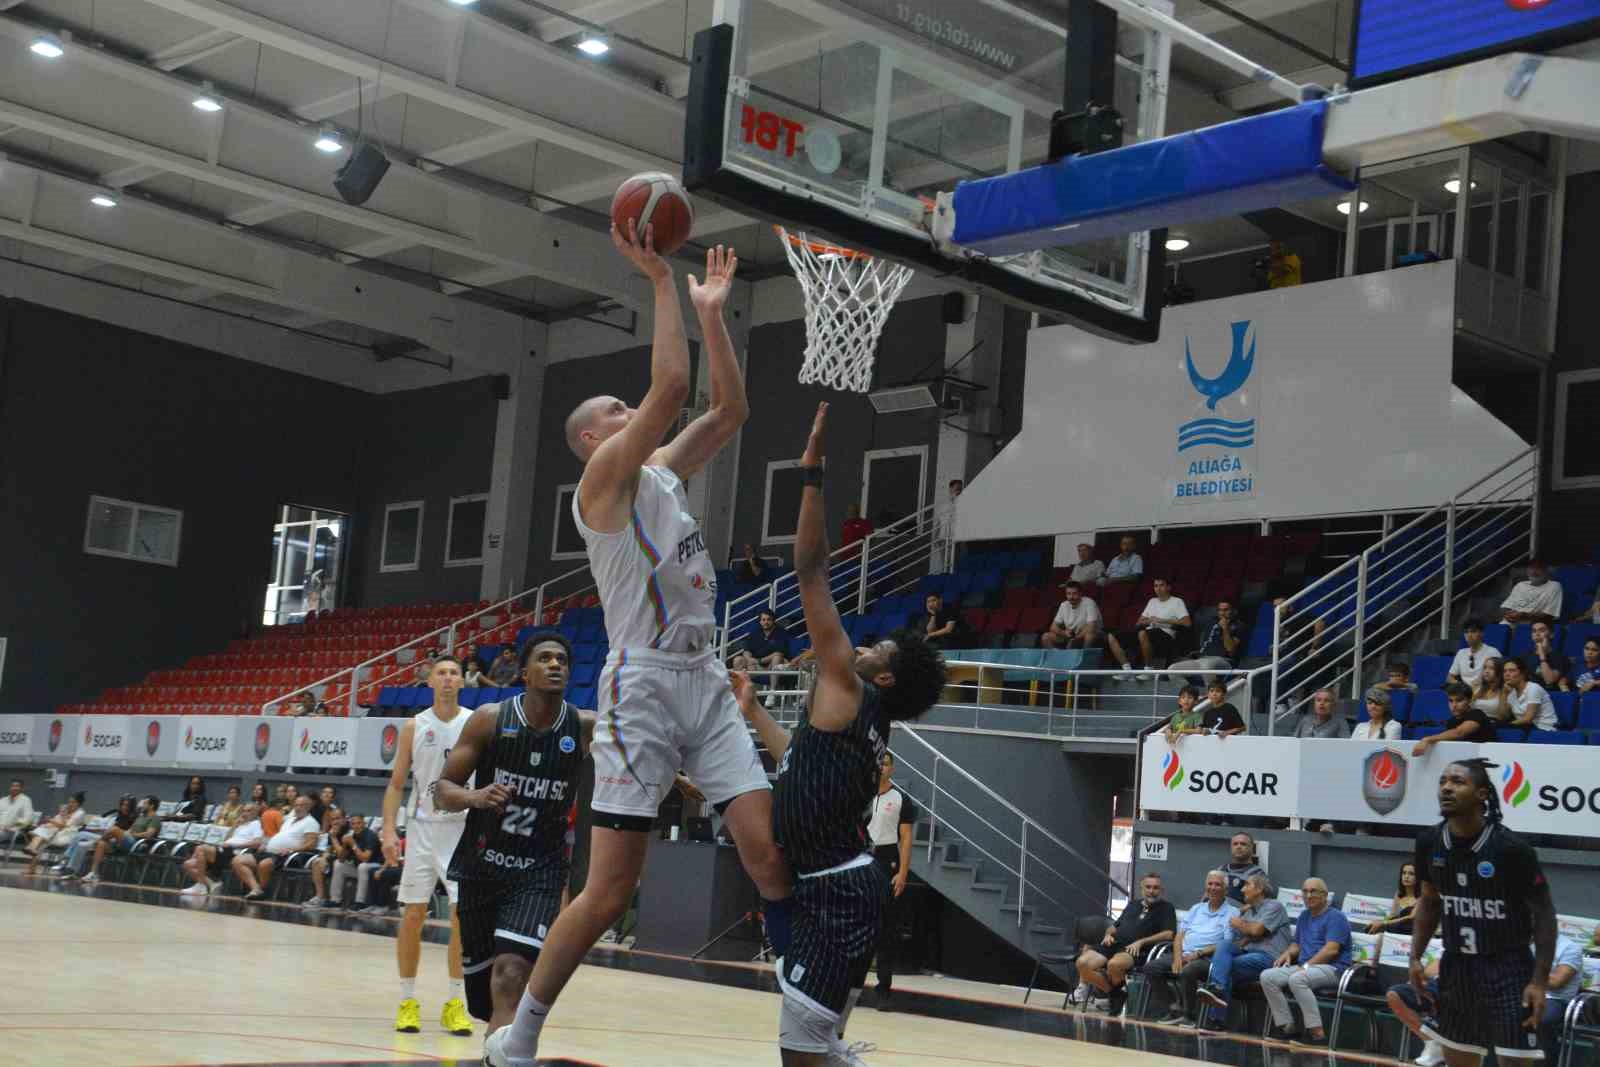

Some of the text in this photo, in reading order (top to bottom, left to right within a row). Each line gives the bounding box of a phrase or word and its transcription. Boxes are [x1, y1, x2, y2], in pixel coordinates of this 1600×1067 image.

[1176, 472, 1253, 497] BELEDİYESİ
[93, 734, 122, 748] SOCAR
[194, 737, 227, 751] SOCAR
[311, 740, 348, 755] SOCAR
[1188, 769, 1278, 796] SOCAR
[501, 803, 538, 837] 22
[1144, 842, 1164, 853] VIP
[1484, 899, 1506, 919] SC
[1459, 926, 1479, 955] 3
